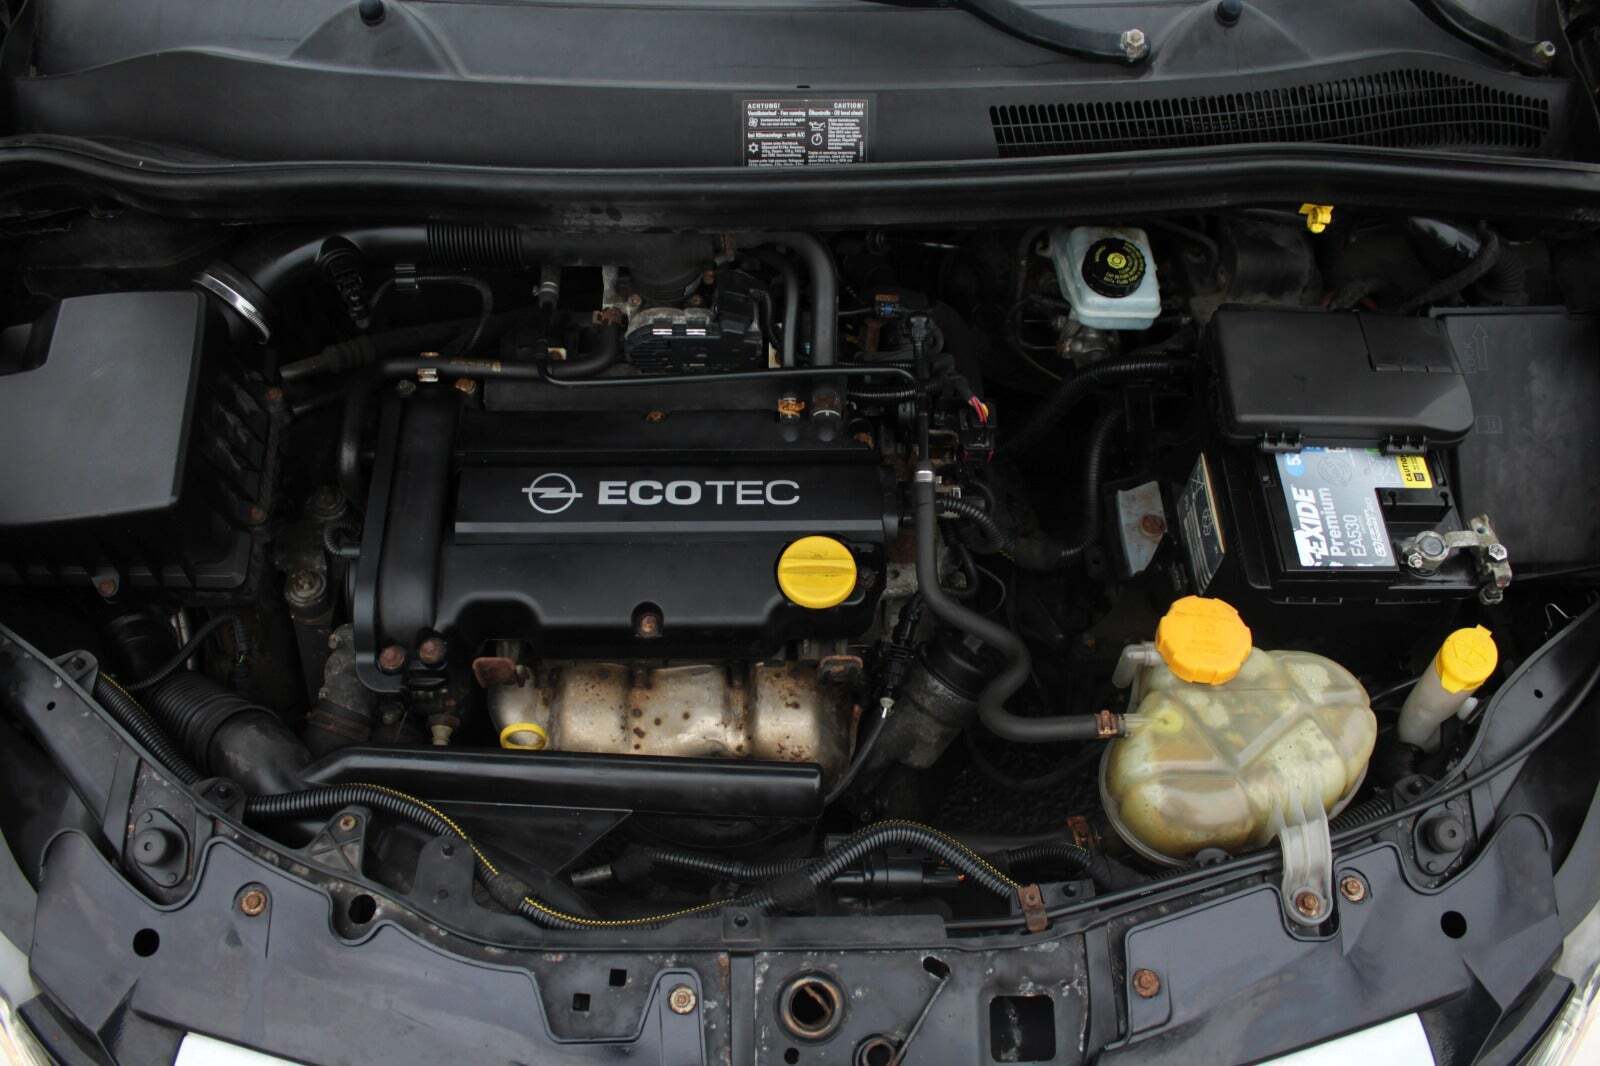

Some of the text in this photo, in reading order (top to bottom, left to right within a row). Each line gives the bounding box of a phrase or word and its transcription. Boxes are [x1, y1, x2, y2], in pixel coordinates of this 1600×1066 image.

[597, 479, 801, 506] ECOTEC
[1291, 485, 1329, 563] EXIDE
[1317, 486, 1347, 558] Premium
[1342, 514, 1368, 558] EA530
